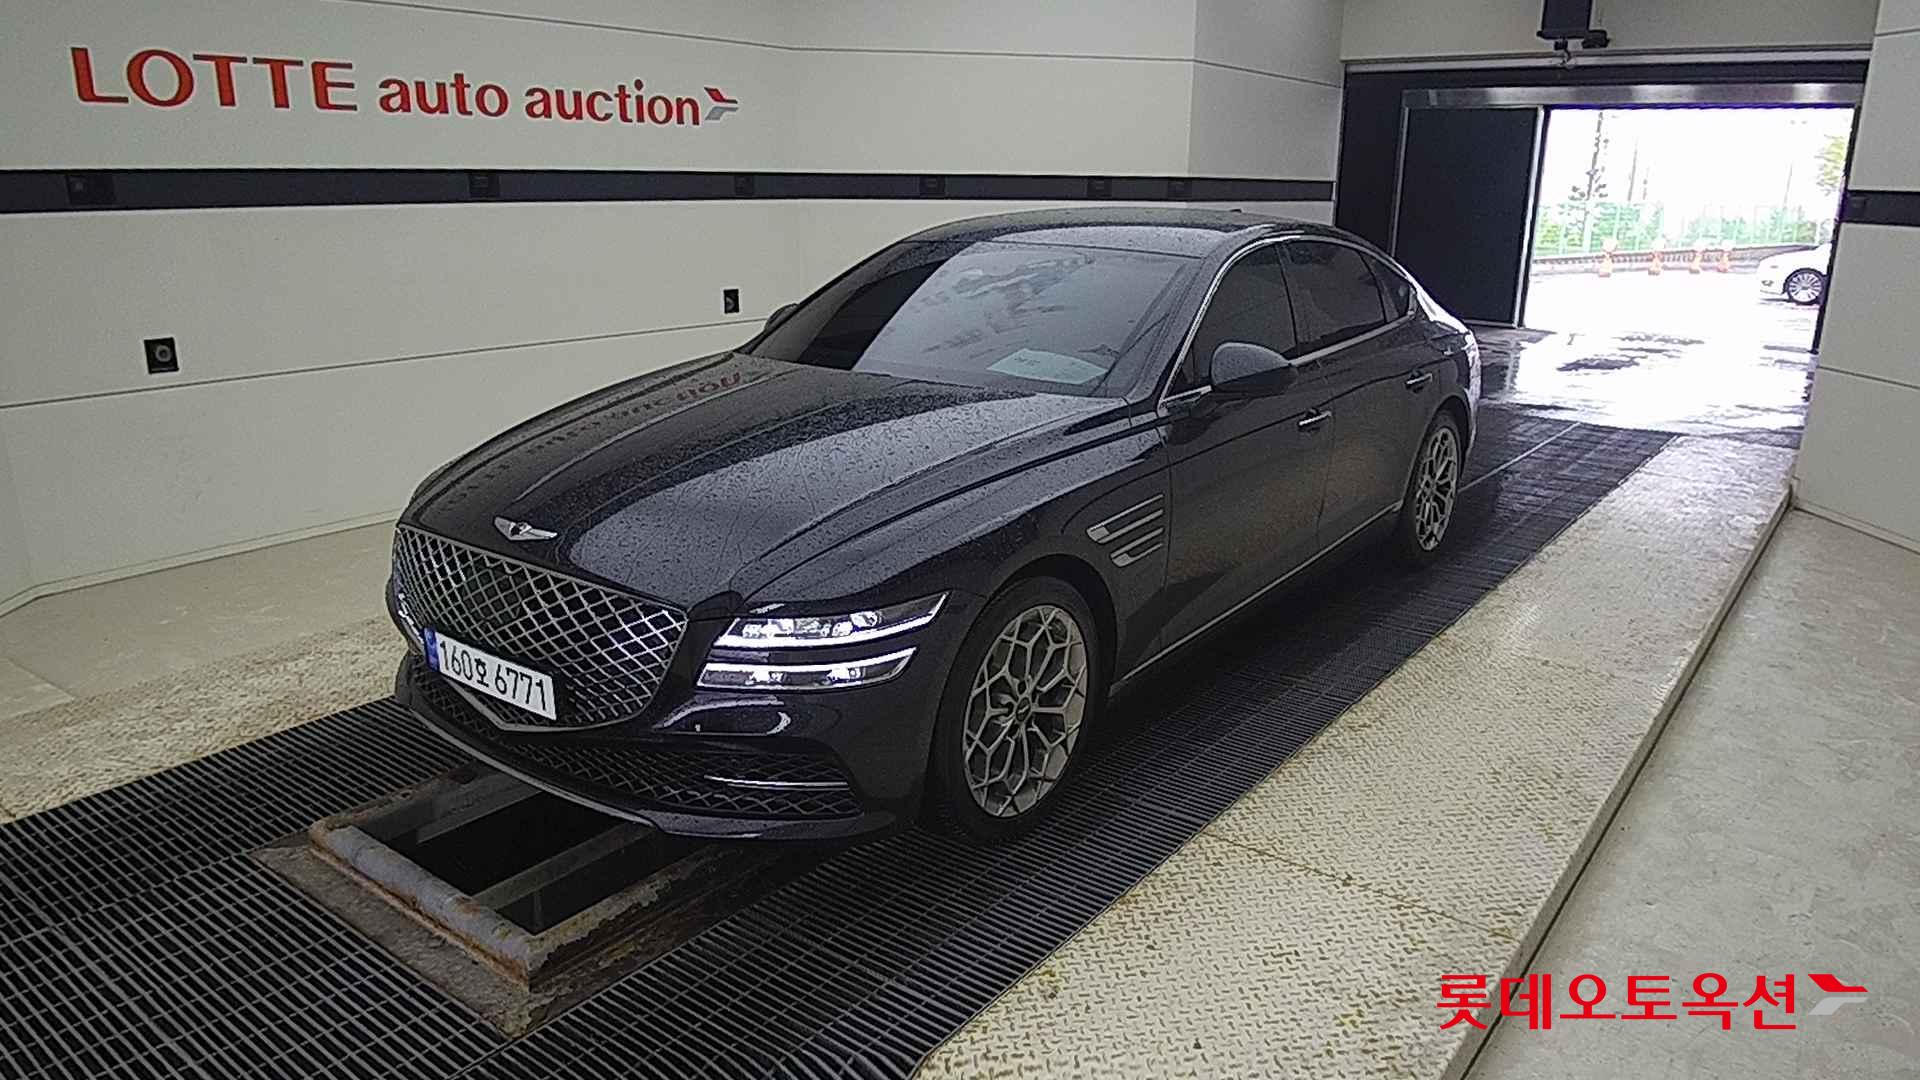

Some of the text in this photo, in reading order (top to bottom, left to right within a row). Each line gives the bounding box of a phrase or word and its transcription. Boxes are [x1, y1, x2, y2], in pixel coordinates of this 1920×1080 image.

[70, 47, 701, 126] LOTTE auto auction
[440, 640, 547, 711] 160호 6771
